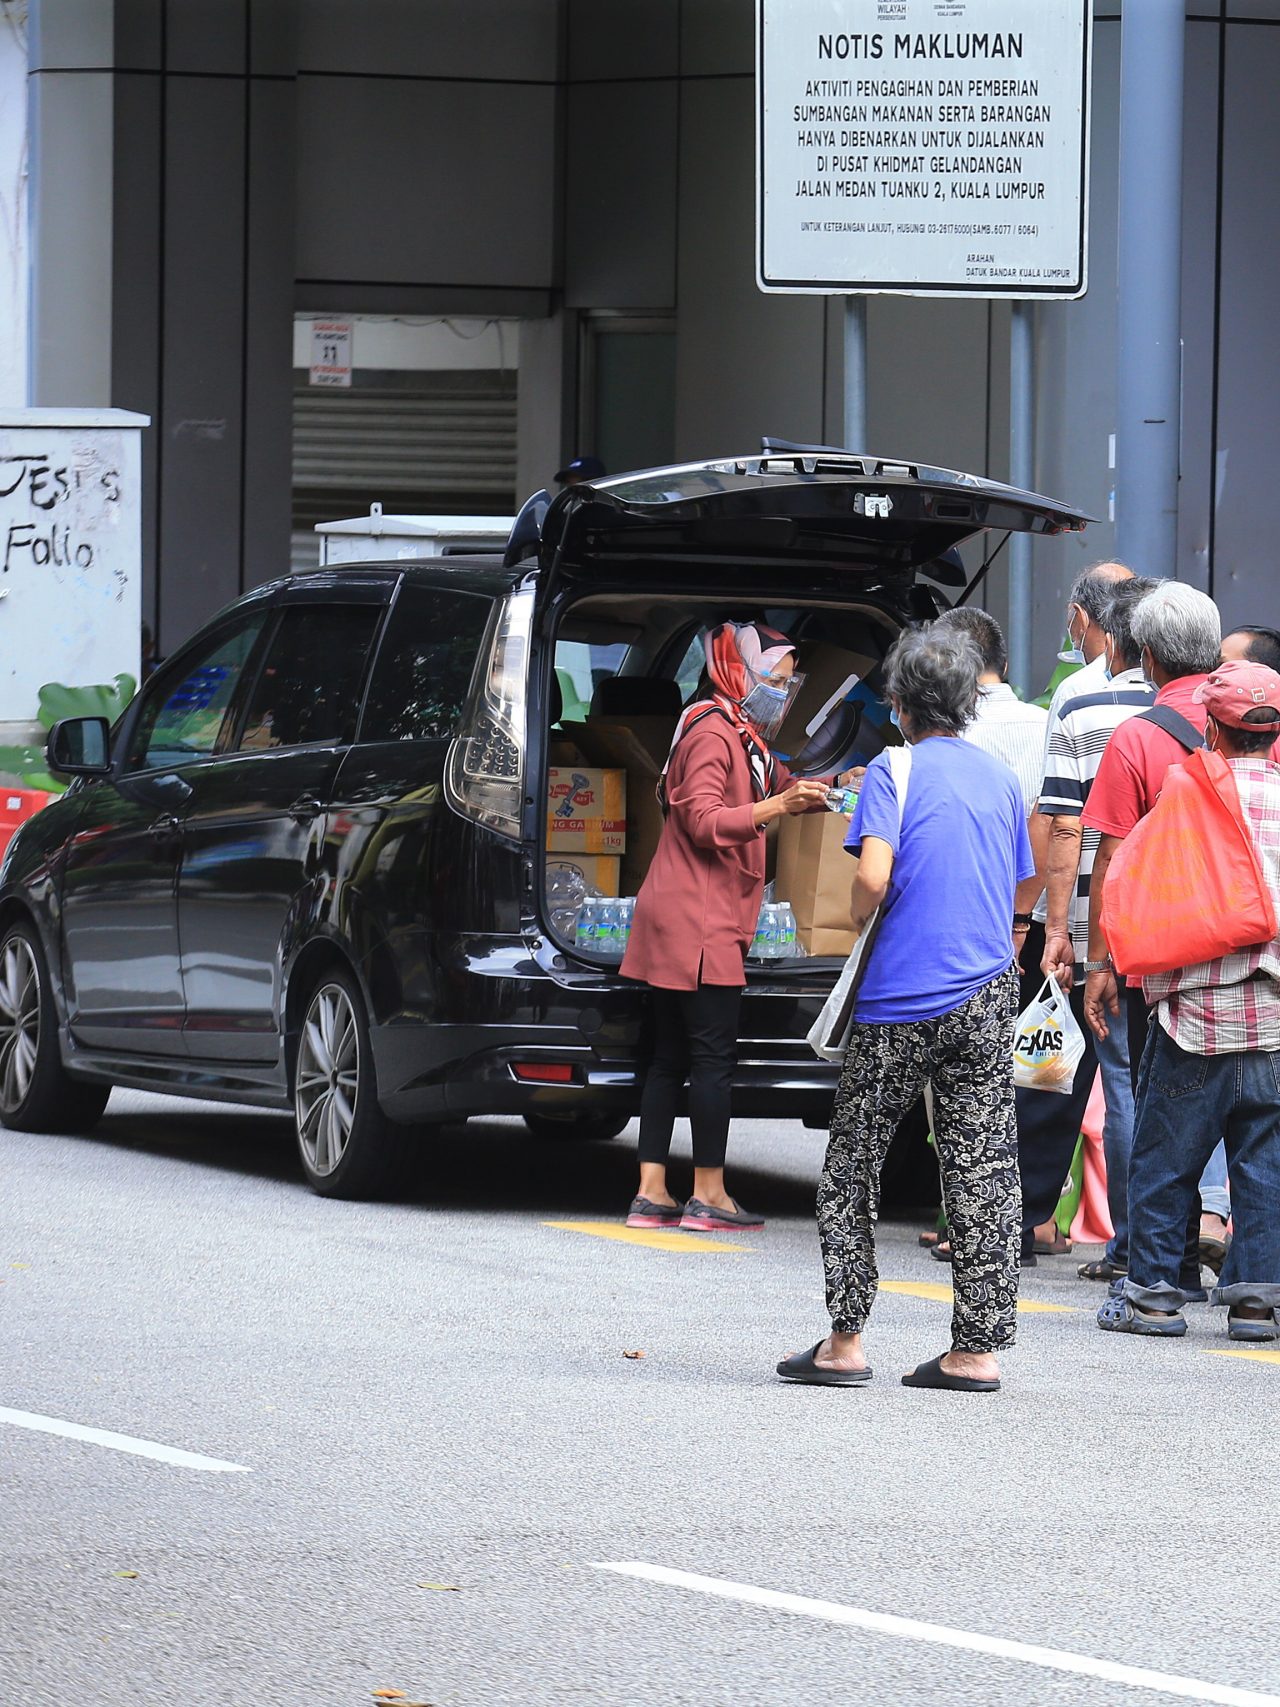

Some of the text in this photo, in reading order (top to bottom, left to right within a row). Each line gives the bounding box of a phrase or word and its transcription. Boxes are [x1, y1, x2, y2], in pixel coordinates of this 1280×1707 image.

[878, 5, 906, 13] WILAYAH
[819, 33, 1022, 59] NOTIS MAKLUMAN
[806, 80, 1038, 96] AKTIVITI PENGAGIHAN DAN PEMBERIAN
[794, 105, 1050, 122] SUMBANGAN MAKANAN SERTA BARANGAN
[798, 131, 1043, 147] HANYA DIBENARKAN UNTUK DIJALANKAN
[818, 156, 1021, 173] DI PUSAT KHIDMAT GELANDANGAN
[796, 181, 1044, 201] JALAN MEDAN TUANKU 2, KUALA LUMPUR
[801, 222, 821, 231] UNTUK
[824, 222, 865, 232] KETERANGAN
[868, 223, 894, 233] LANJUT,
[967, 254, 994, 262] ARAHAN
[966, 268, 1070, 278] DATUK BANDAR KUALA LUMPUR
